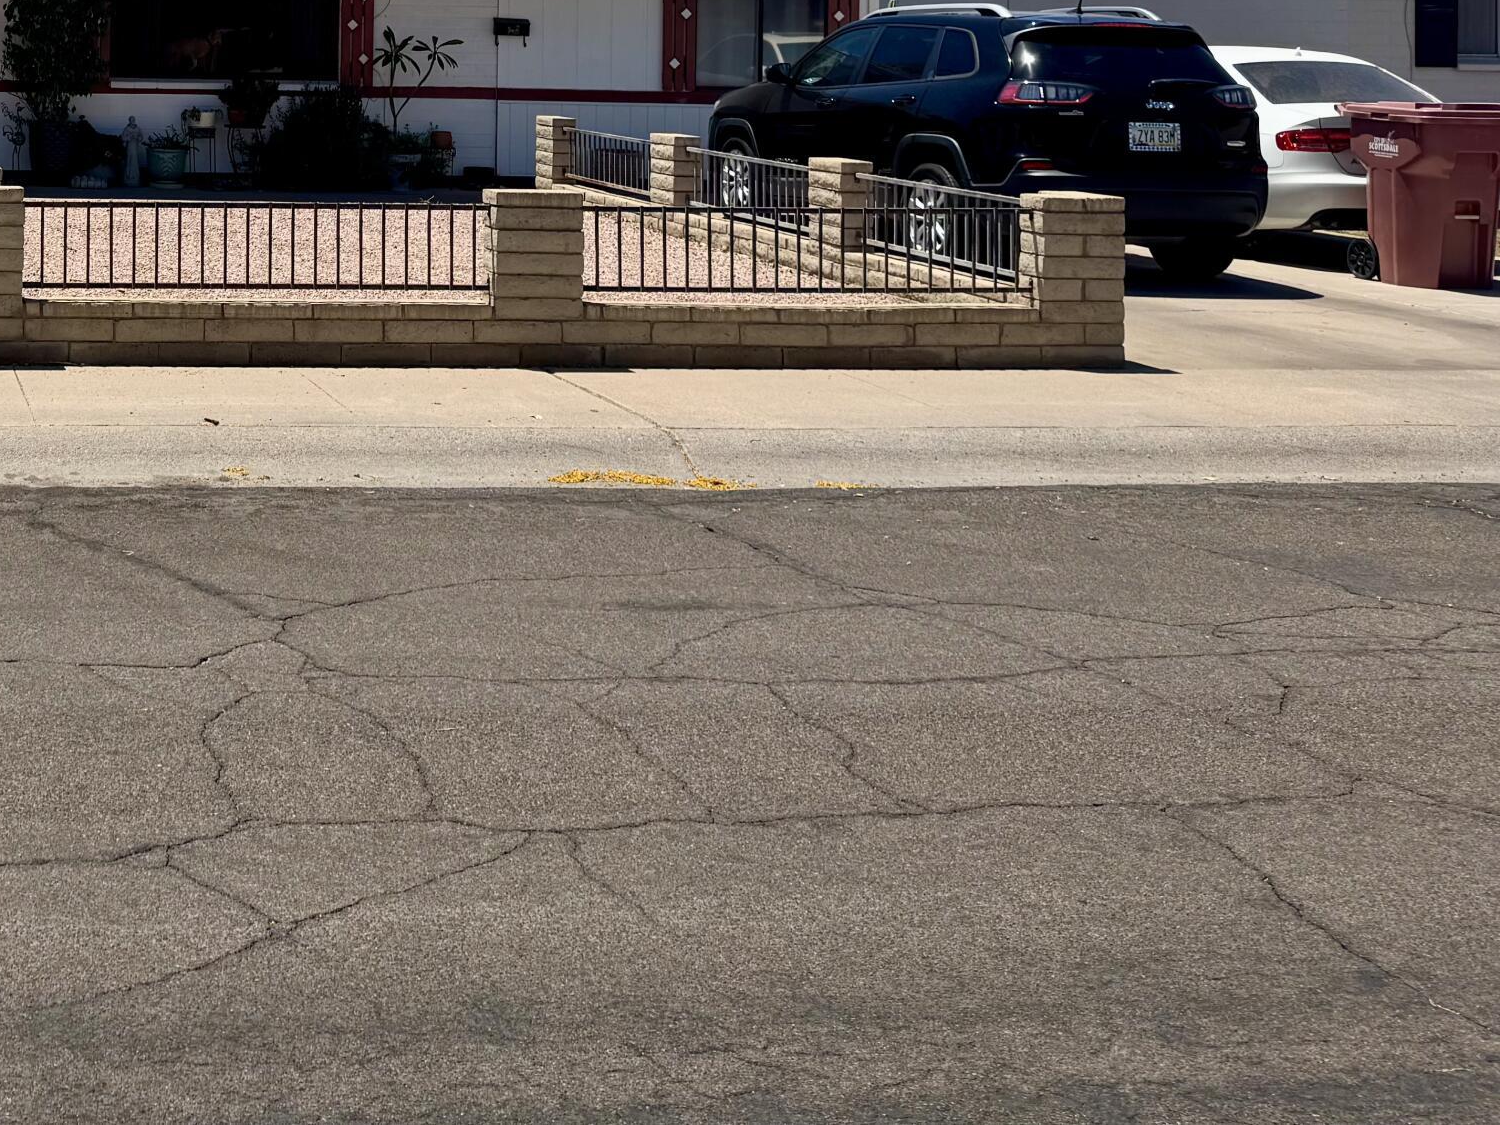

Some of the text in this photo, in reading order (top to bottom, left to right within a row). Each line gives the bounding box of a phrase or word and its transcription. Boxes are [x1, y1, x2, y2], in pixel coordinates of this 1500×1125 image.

[1145, 98, 1175, 111] Jeep
[1137, 129, 1176, 143] ZYA 83M
